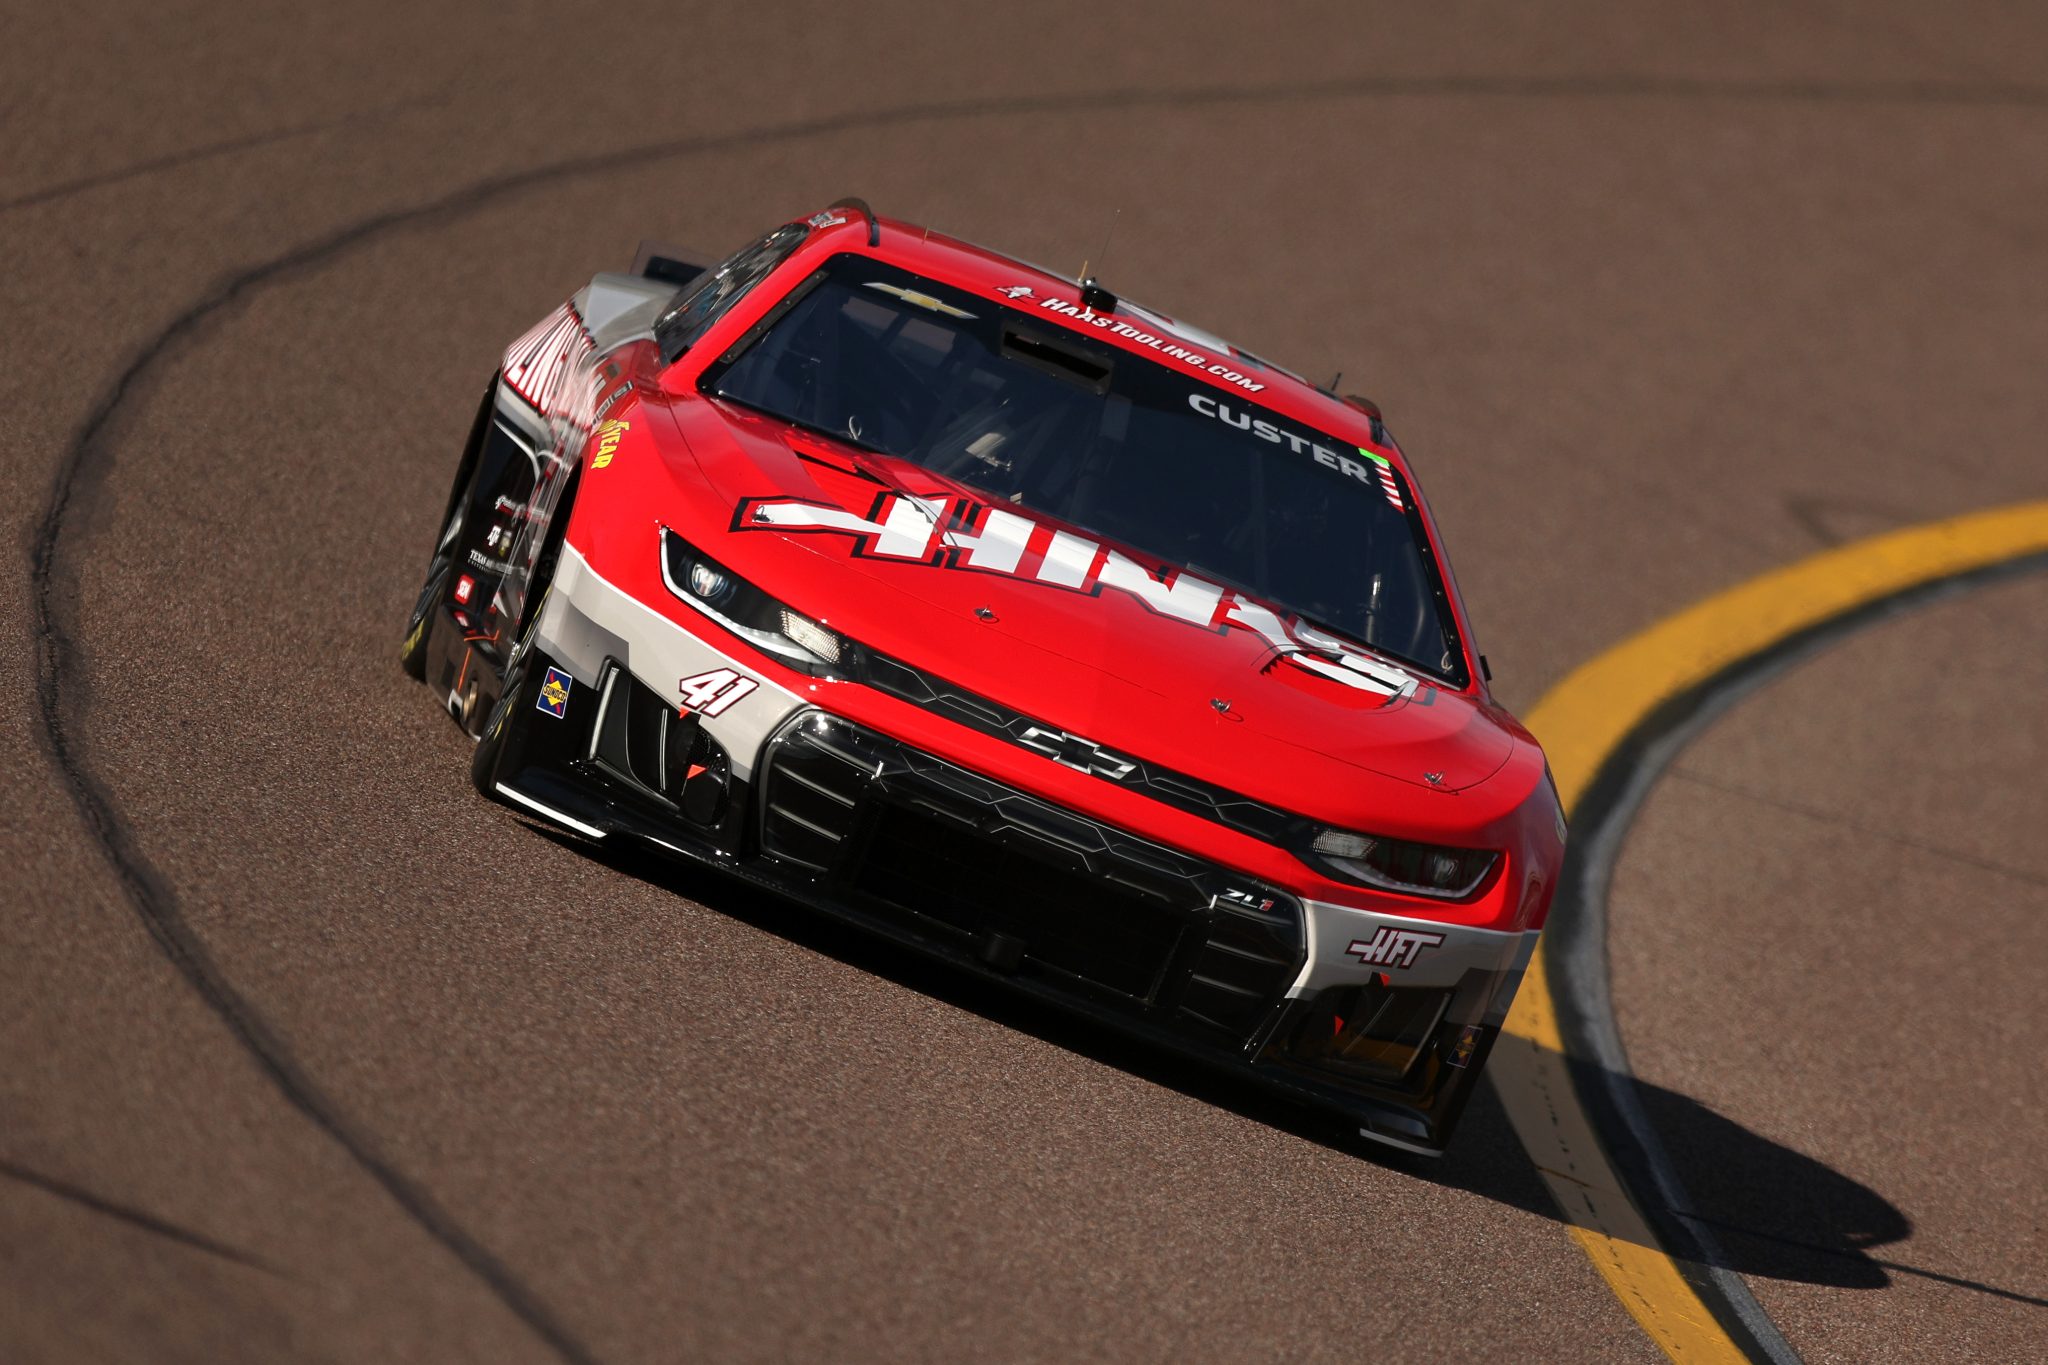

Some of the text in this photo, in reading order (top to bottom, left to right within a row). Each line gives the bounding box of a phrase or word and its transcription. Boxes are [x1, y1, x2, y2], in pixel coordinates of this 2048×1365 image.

[1040, 298, 1265, 392] HAASTOOLING.COM
[1188, 393, 1371, 486] CUSTER
[679, 667, 760, 718] 41
[1219, 887, 1275, 912] ZL1
[1345, 925, 1446, 970] HFT
